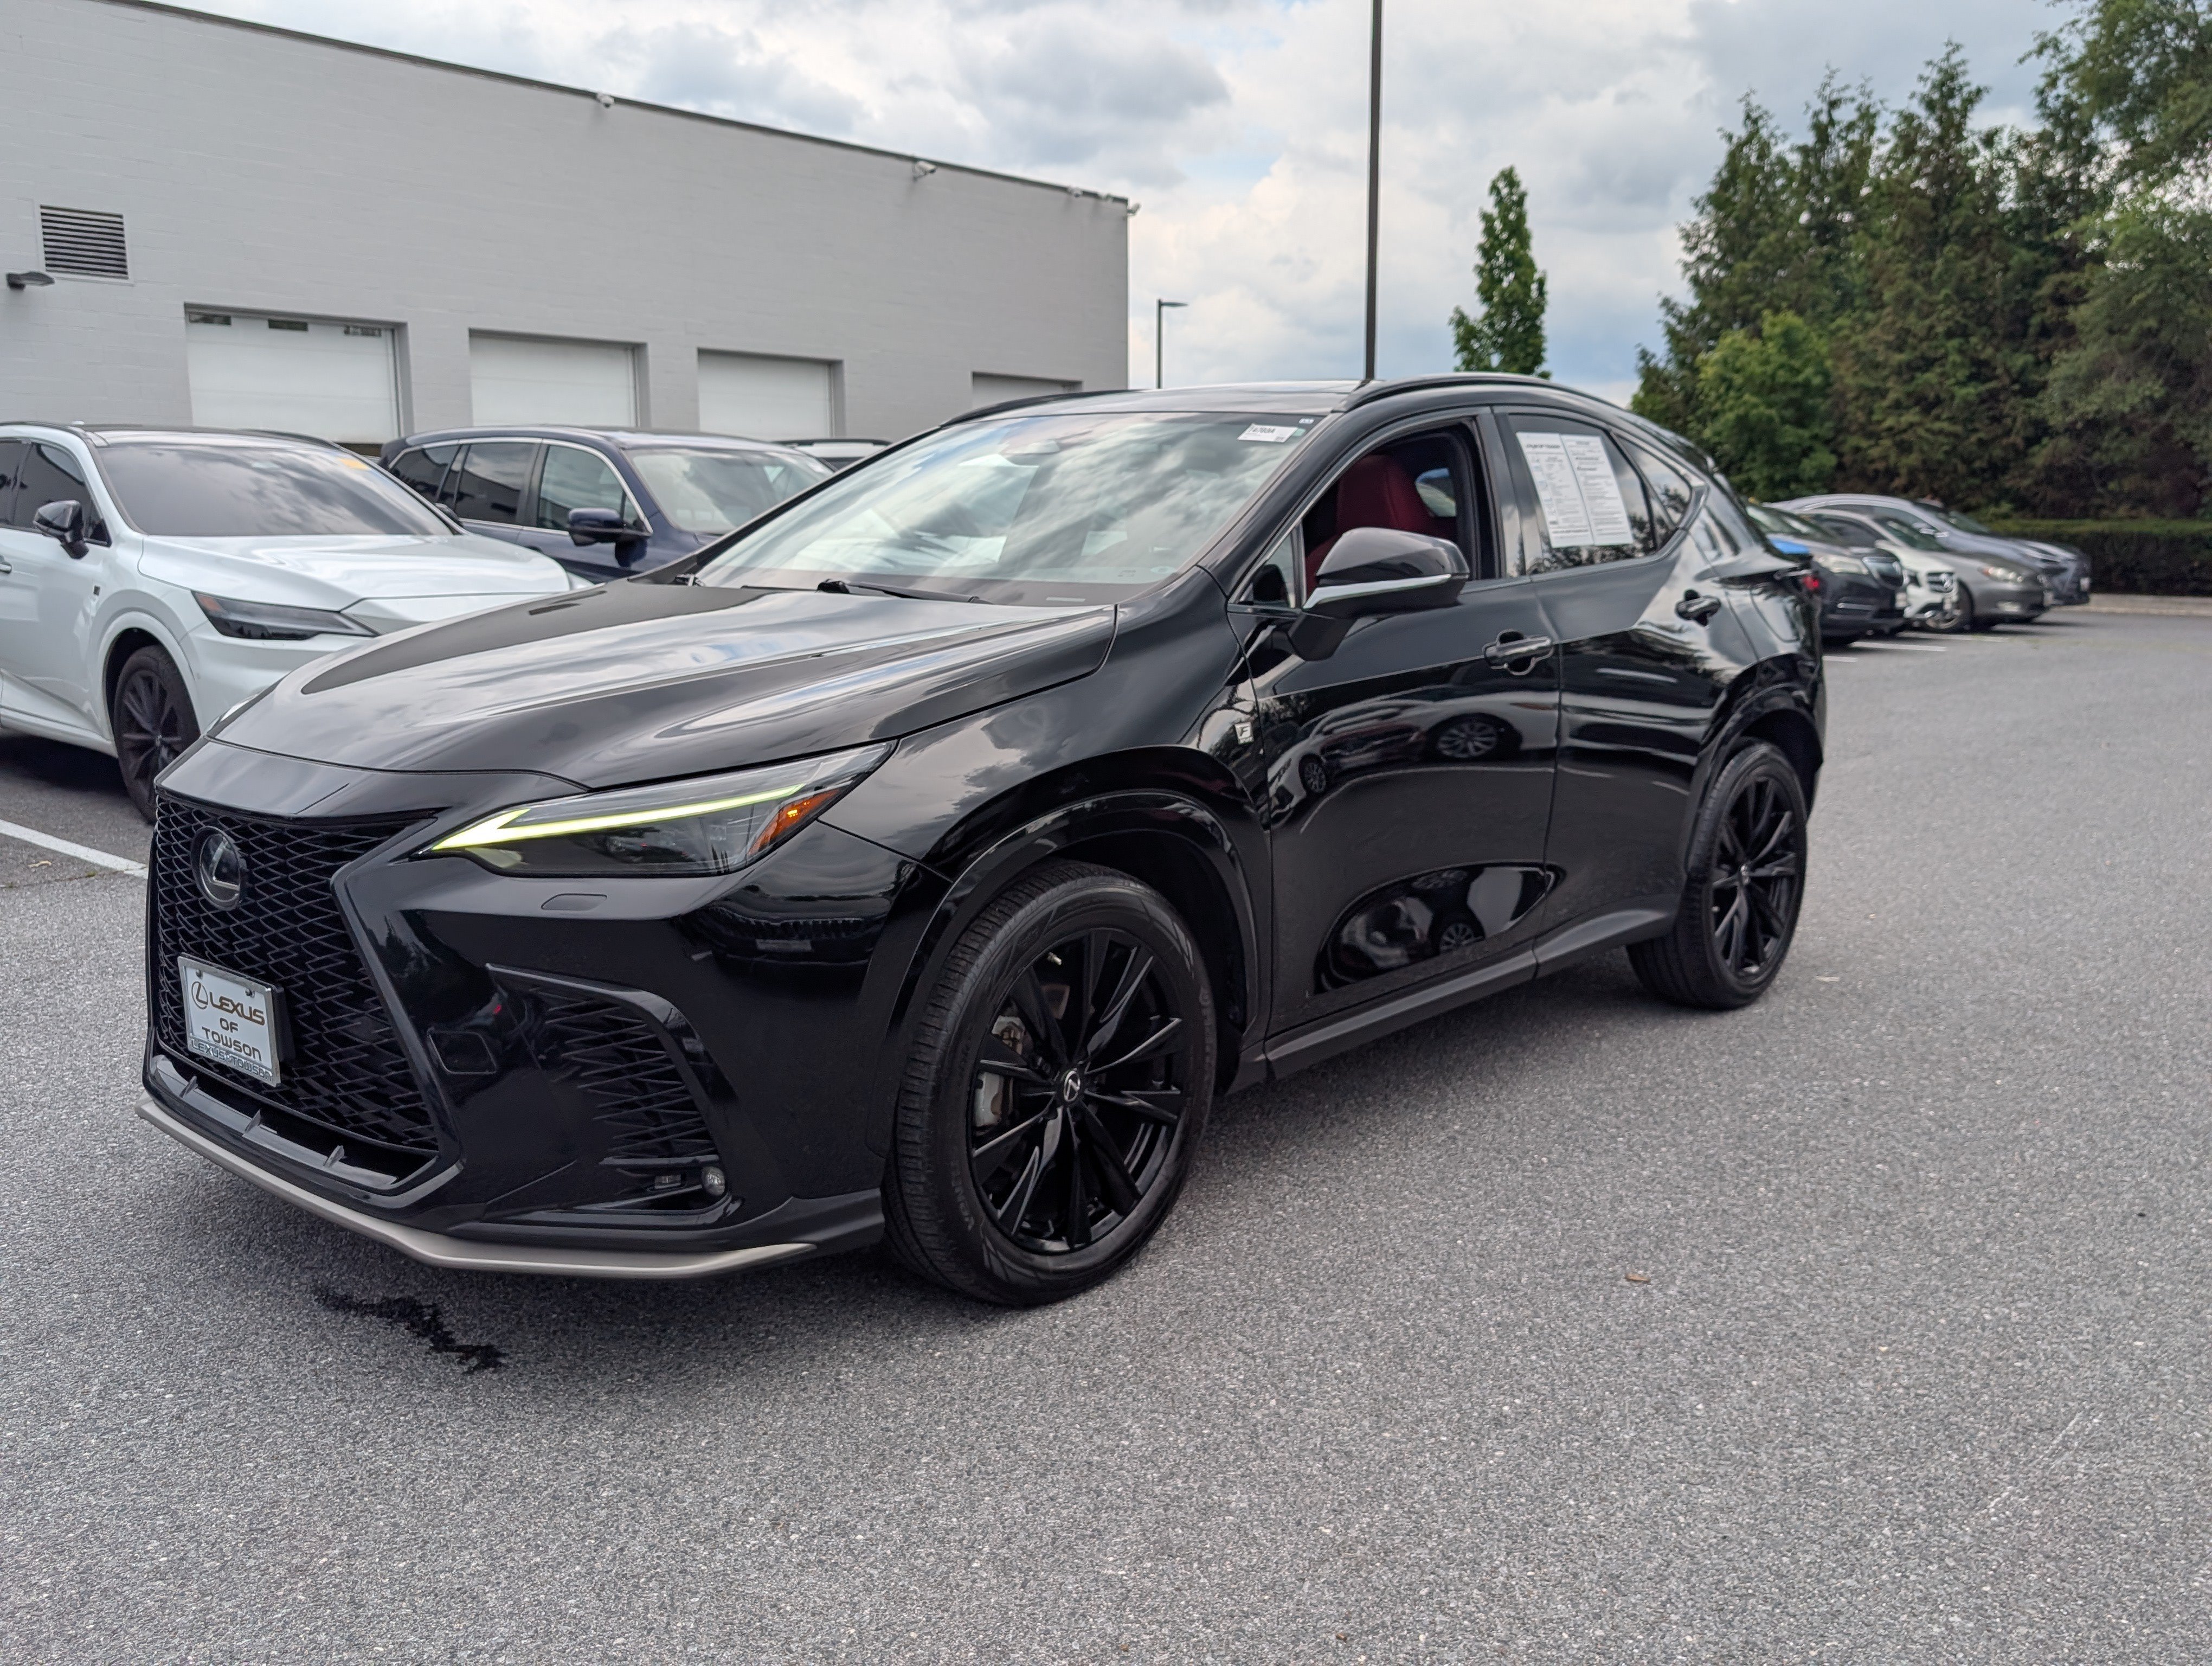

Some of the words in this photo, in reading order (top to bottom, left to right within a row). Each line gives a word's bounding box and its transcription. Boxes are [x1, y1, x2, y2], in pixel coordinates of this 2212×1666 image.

[209, 991, 265, 1026] LEXUS
[219, 1017, 239, 1033] OF
[191, 1038, 226, 1060] LEXUS
[202, 1026, 262, 1062] TOWSON
